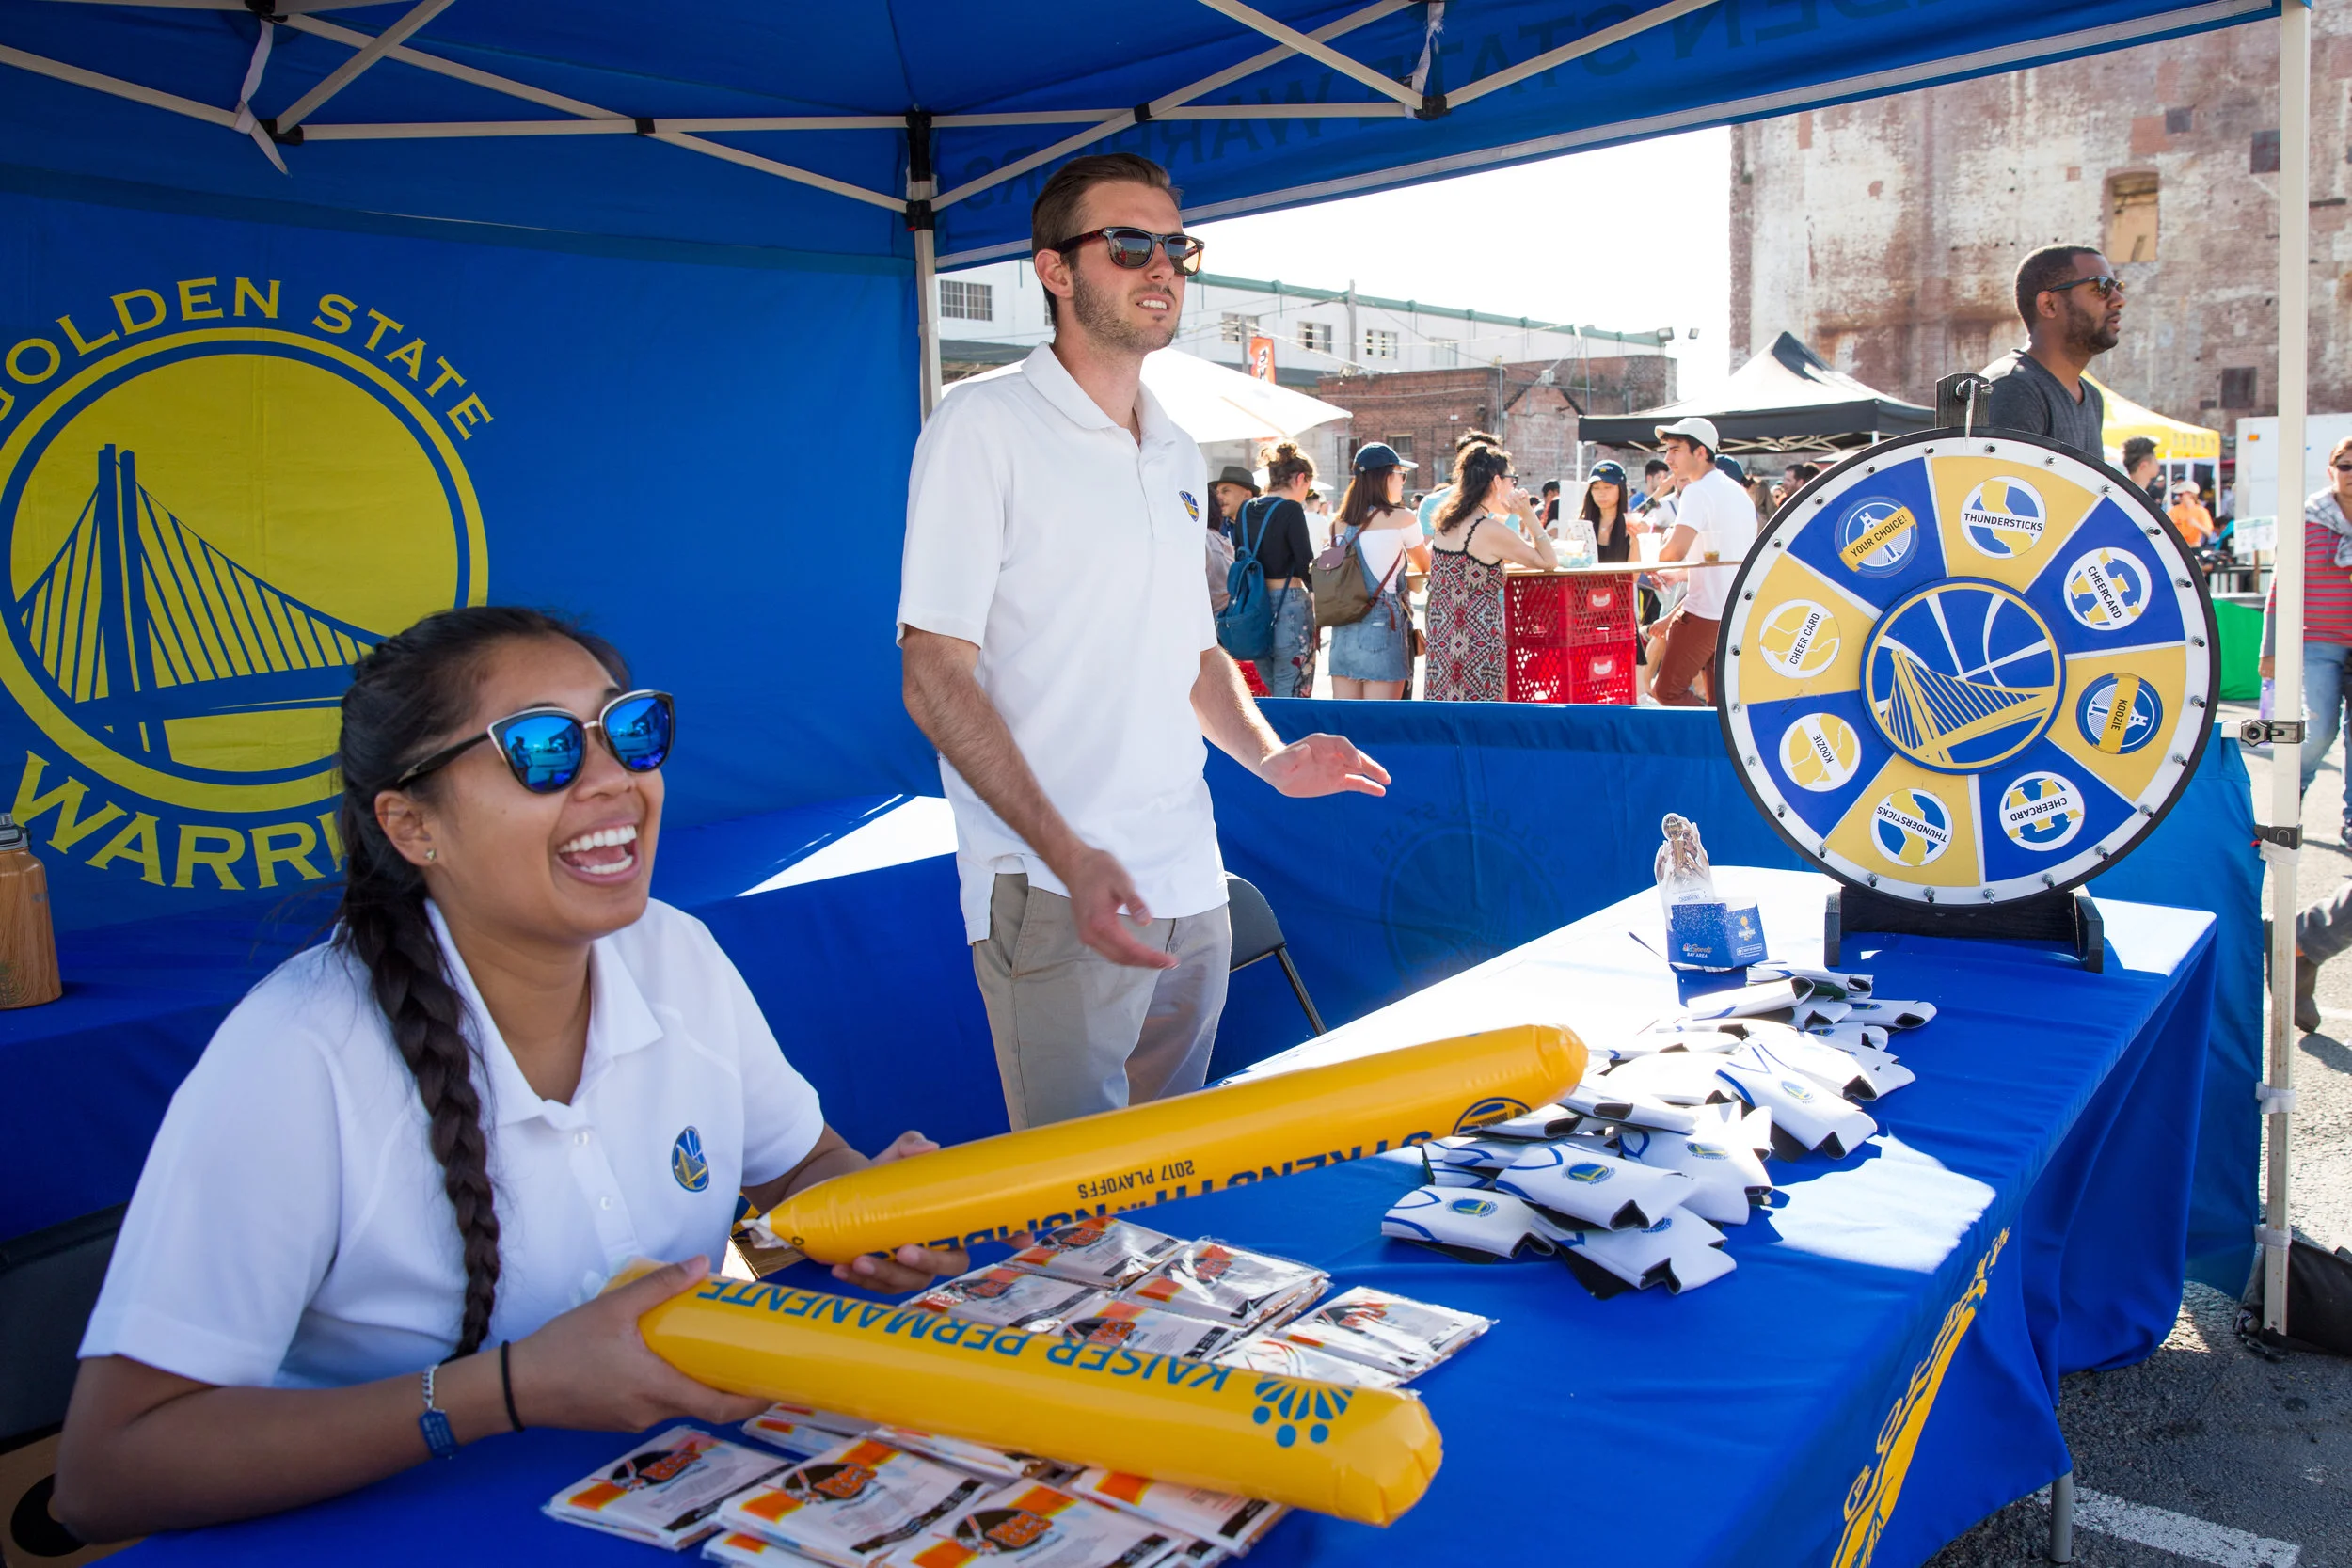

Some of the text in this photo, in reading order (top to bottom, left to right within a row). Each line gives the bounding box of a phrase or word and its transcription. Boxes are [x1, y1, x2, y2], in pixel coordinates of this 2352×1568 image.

[311, 293, 494, 441] STATE
[1851, 515, 1907, 557] YOUR CHOICE!
[1963, 513, 2043, 531] THUNDERSTICKS
[2087, 565, 2122, 619] CHEERCARD
[1789, 612, 1820, 665] CHEER CARD
[2110, 699, 2128, 731] KOOZIE
[1812, 734, 1835, 764] KOOZIE
[11, 750, 348, 891] WARRI
[1876, 806, 1947, 843] THUNDERSTICKS
[2010, 797, 2068, 822] CHEERCARD
[1078, 1159, 1196, 1200] 2017 PLAYOFFS
[697, 1278, 1031, 1357] PERMANENTE
[1045, 1336, 1232, 1392] KAISER
